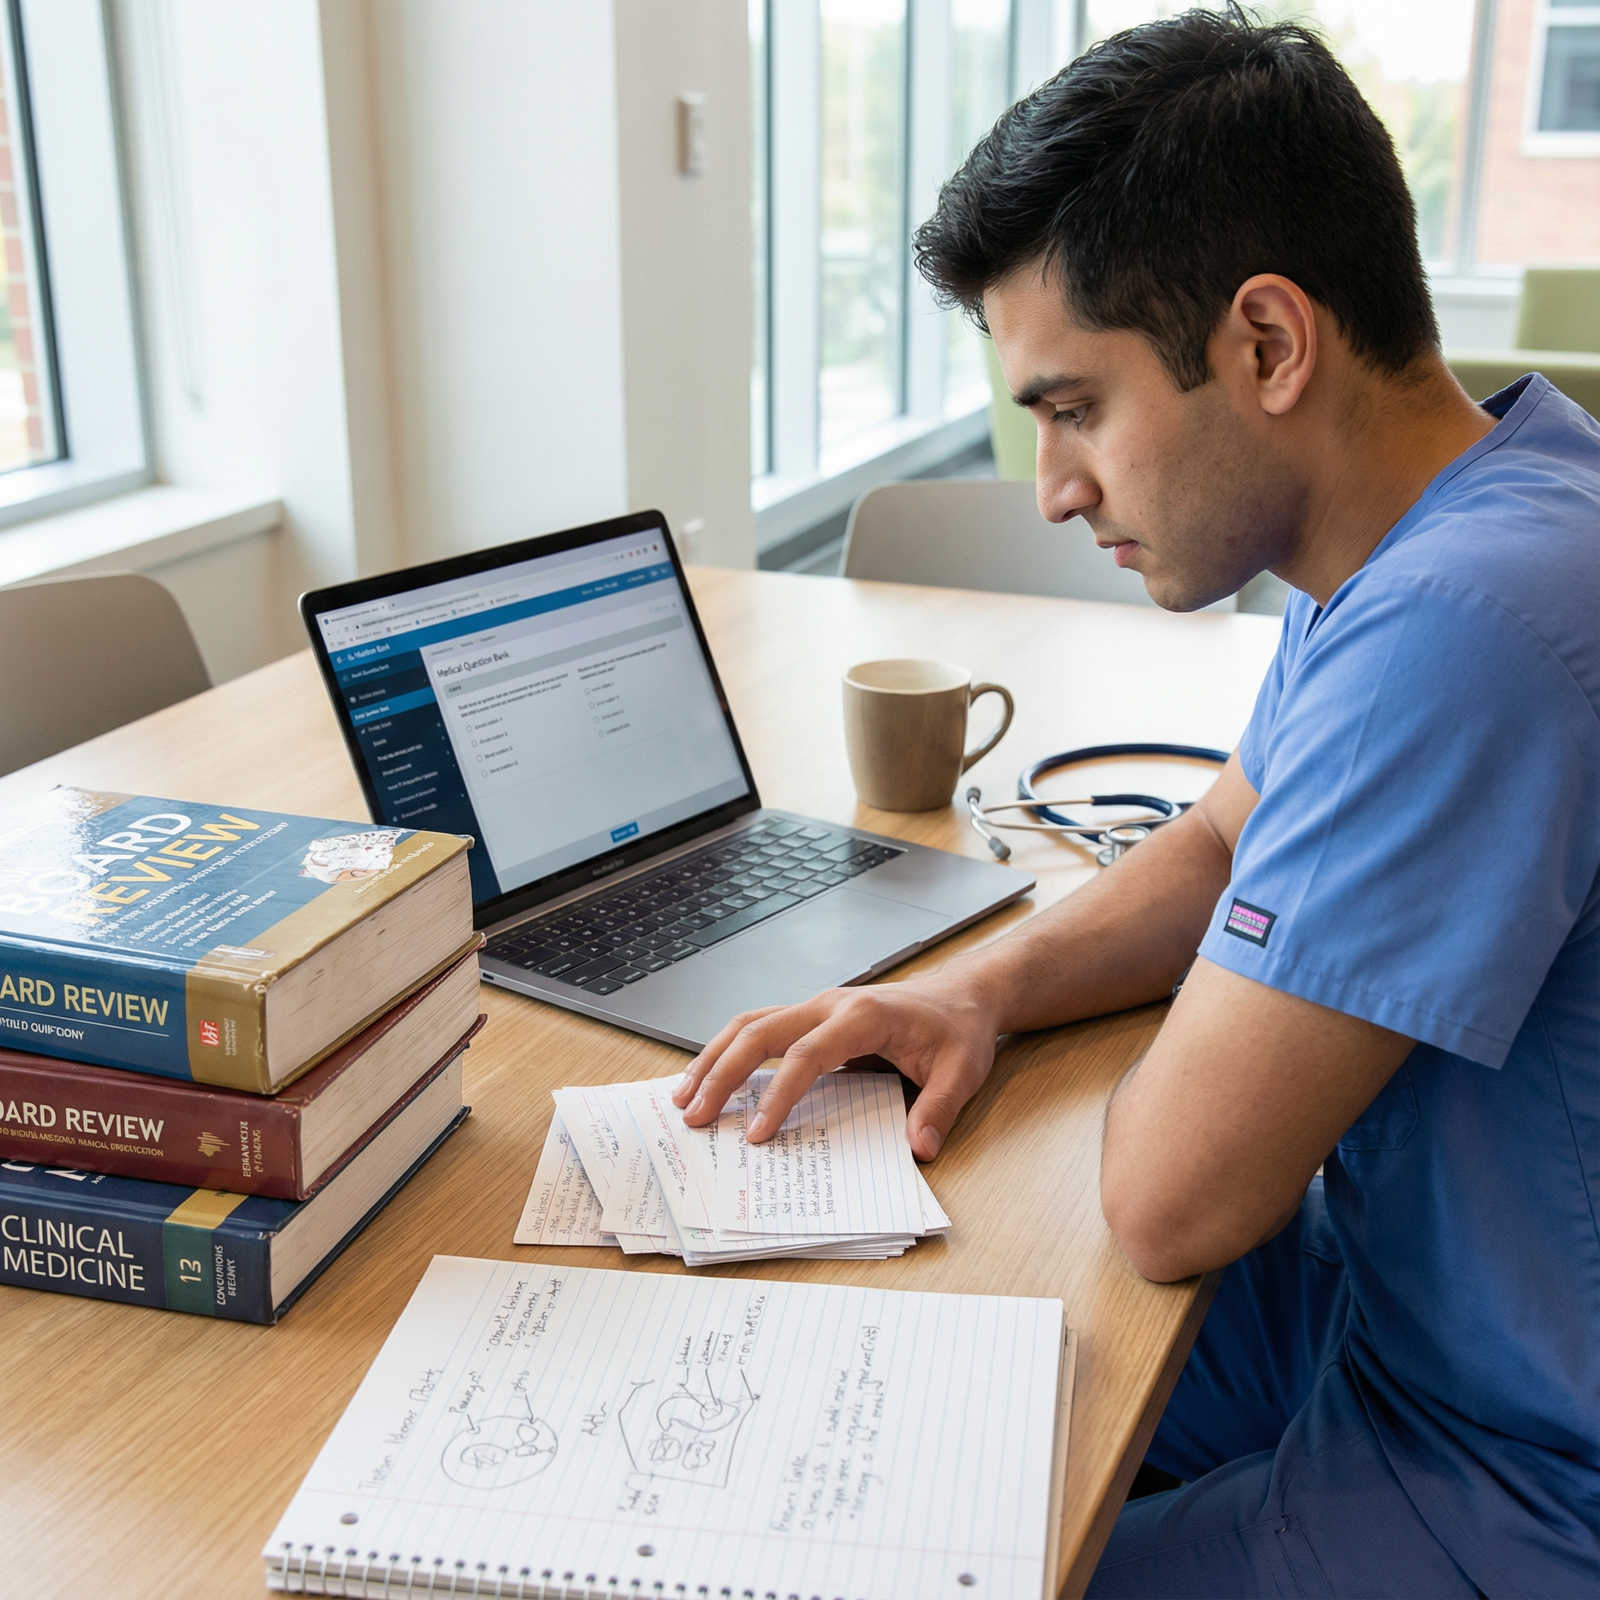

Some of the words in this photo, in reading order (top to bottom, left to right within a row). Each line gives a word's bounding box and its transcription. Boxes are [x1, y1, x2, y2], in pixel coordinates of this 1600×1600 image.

[464, 657, 493, 671] Question
[0, 813, 192, 916] BOARD
[52, 813, 261, 926] REVIEW
[64, 984, 169, 1026] REVIEW
[0, 1100, 57, 1127] ARD
[65, 1107, 165, 1143] REVIEW
[1, 1214, 135, 1259] CLINICAL
[3, 1246, 146, 1292] MEDICINE
[179, 1258, 202, 1284] 13
